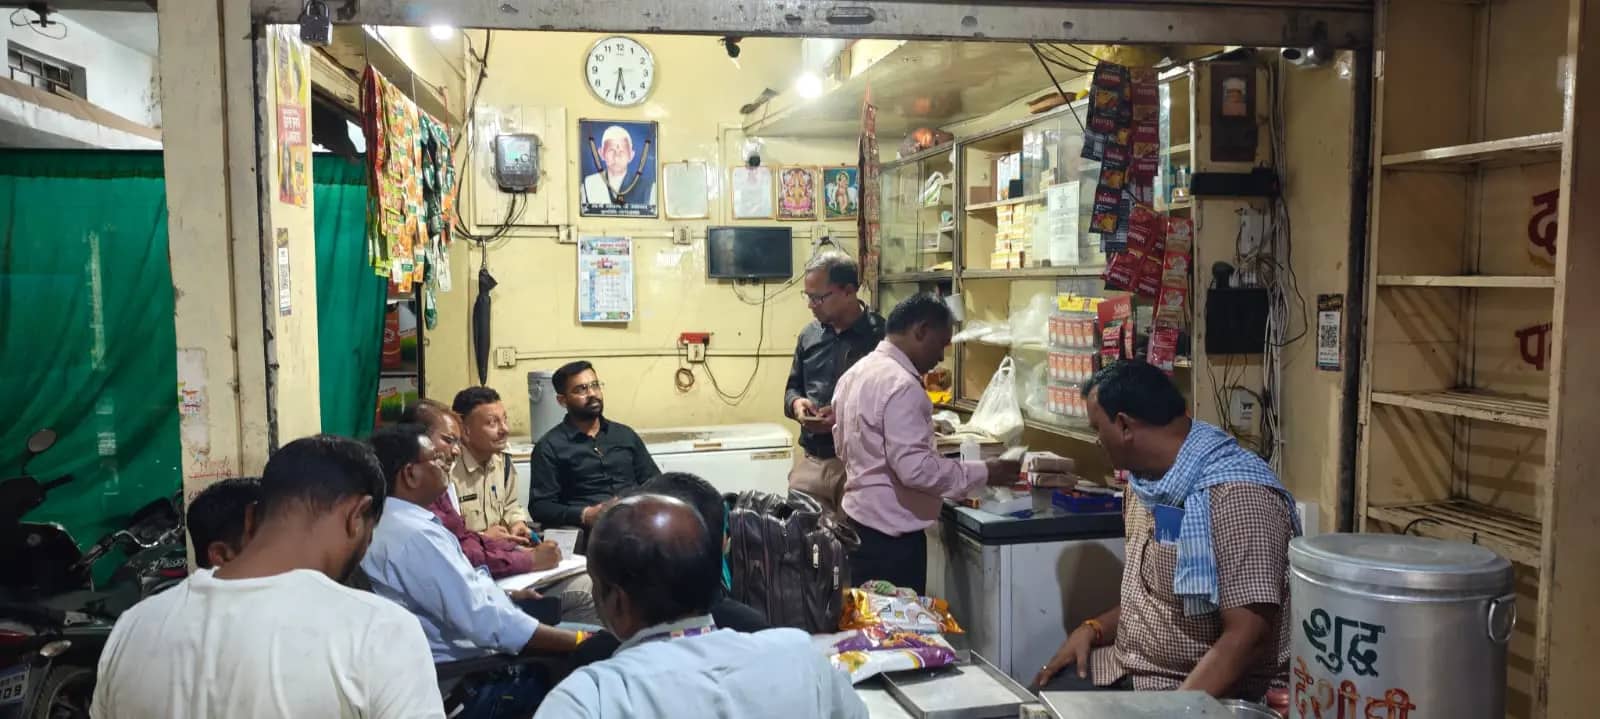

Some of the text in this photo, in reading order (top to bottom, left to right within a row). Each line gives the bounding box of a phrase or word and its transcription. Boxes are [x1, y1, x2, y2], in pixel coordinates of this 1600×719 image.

[604, 45, 611, 53] 11
[616, 43, 624, 51] 12
[592, 65, 598, 74] 9
[1515, 322, 1552, 371] प
[1302, 608, 1386, 677] शुद्ध
